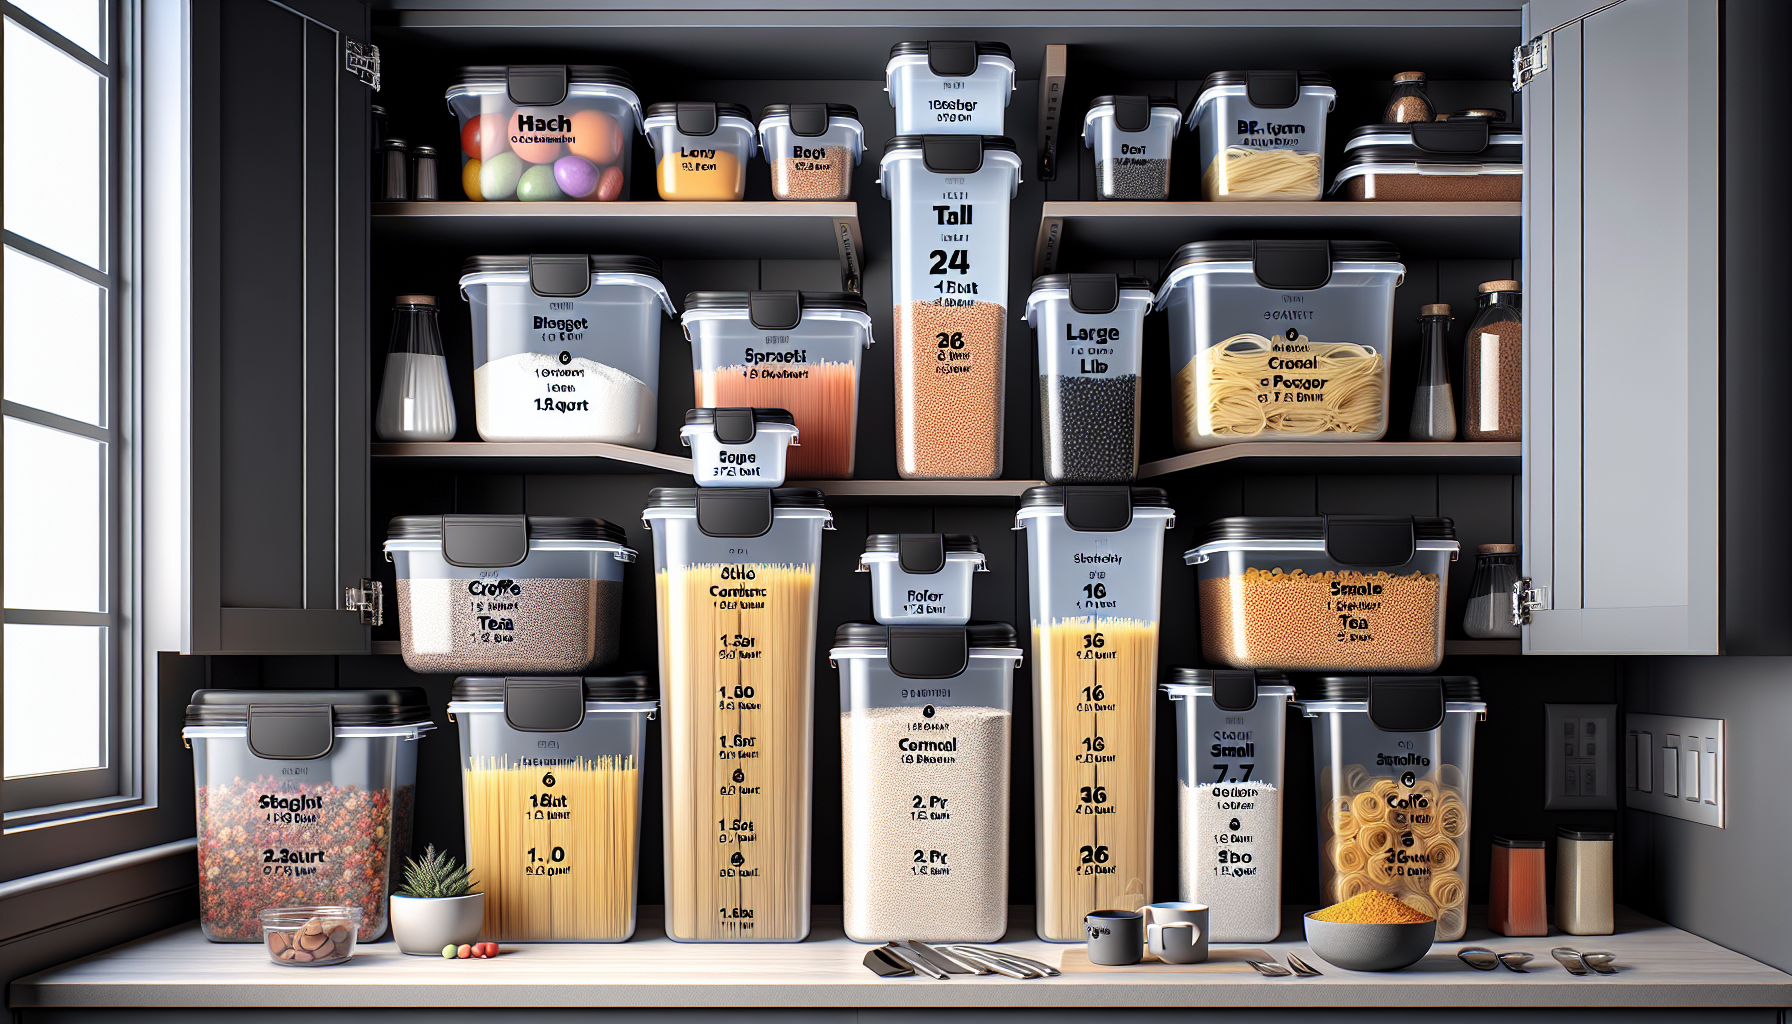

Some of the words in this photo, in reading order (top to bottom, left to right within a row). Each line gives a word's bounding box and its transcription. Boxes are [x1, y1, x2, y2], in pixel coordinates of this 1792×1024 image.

[518, 114, 572, 132] Hach
[933, 204, 973, 225] Tall
[929, 249, 970, 275] 24
[1066, 323, 1120, 345] Large
[1081, 685, 1105, 702] 16
[1212, 763, 1255, 783] 7.7
[1079, 845, 1109, 864] 26
